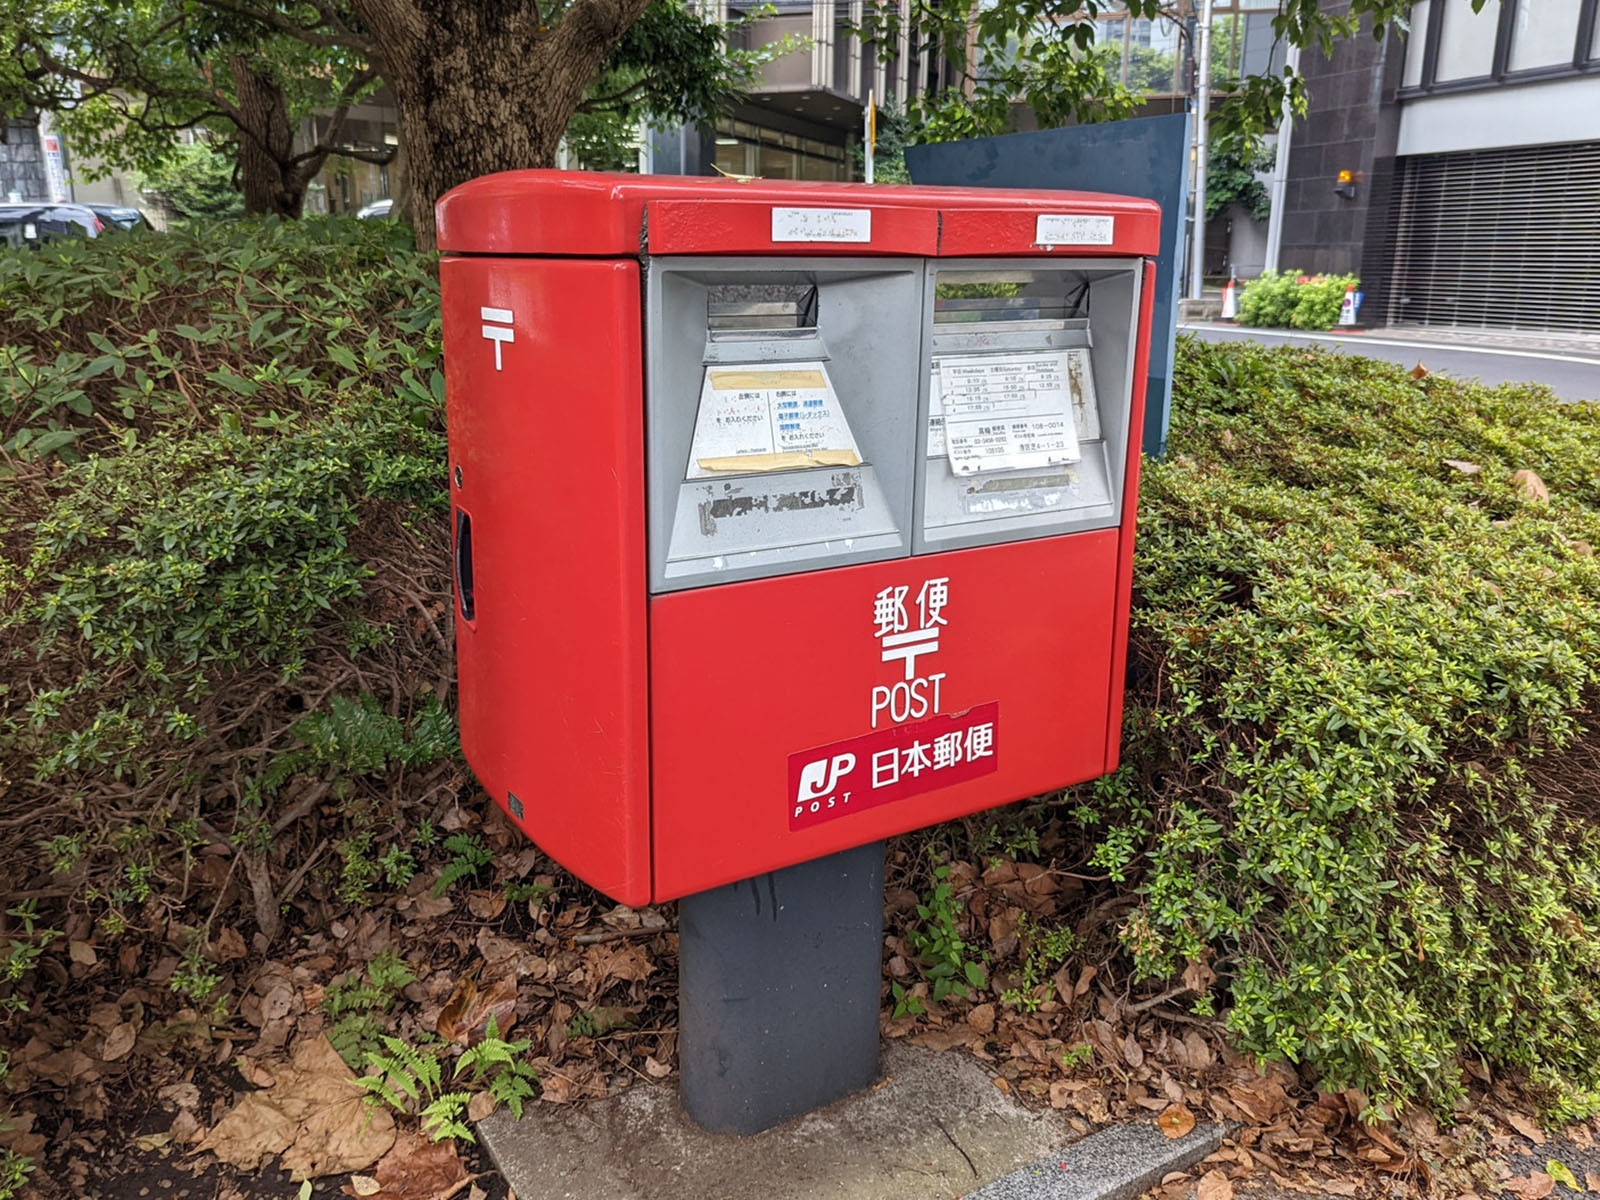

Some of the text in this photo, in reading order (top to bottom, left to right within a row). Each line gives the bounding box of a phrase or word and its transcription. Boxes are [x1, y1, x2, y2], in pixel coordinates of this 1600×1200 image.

[1032, 422, 1064, 430] 108-0014
[873, 577, 950, 638] 郵便
[871, 673, 947, 729] POST
[871, 722, 994, 789] 日本郵便
[794, 791, 852, 818] POST
